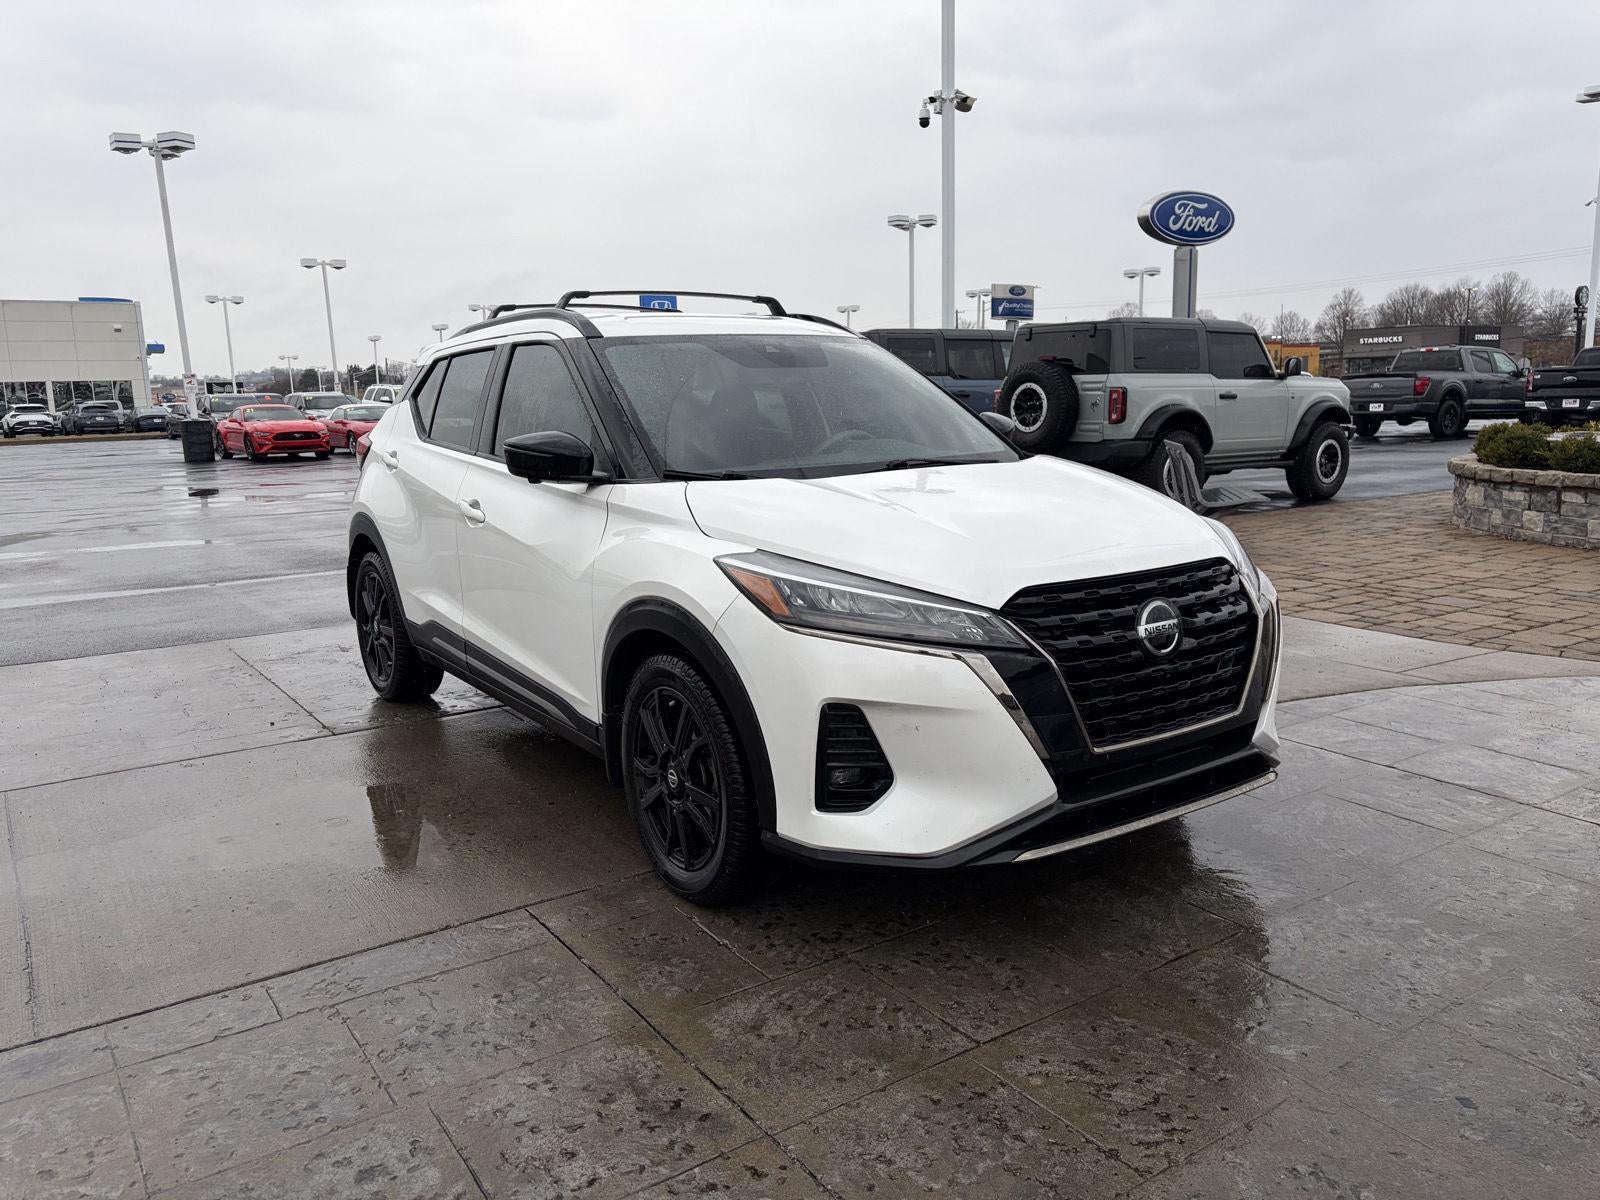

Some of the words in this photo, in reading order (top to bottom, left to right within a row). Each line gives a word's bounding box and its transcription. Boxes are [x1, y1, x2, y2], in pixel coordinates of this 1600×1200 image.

[1168, 200, 1220, 232] Ford
[1359, 336, 1403, 344] STARBUCKS
[1144, 623, 1178, 636] NISSAN
